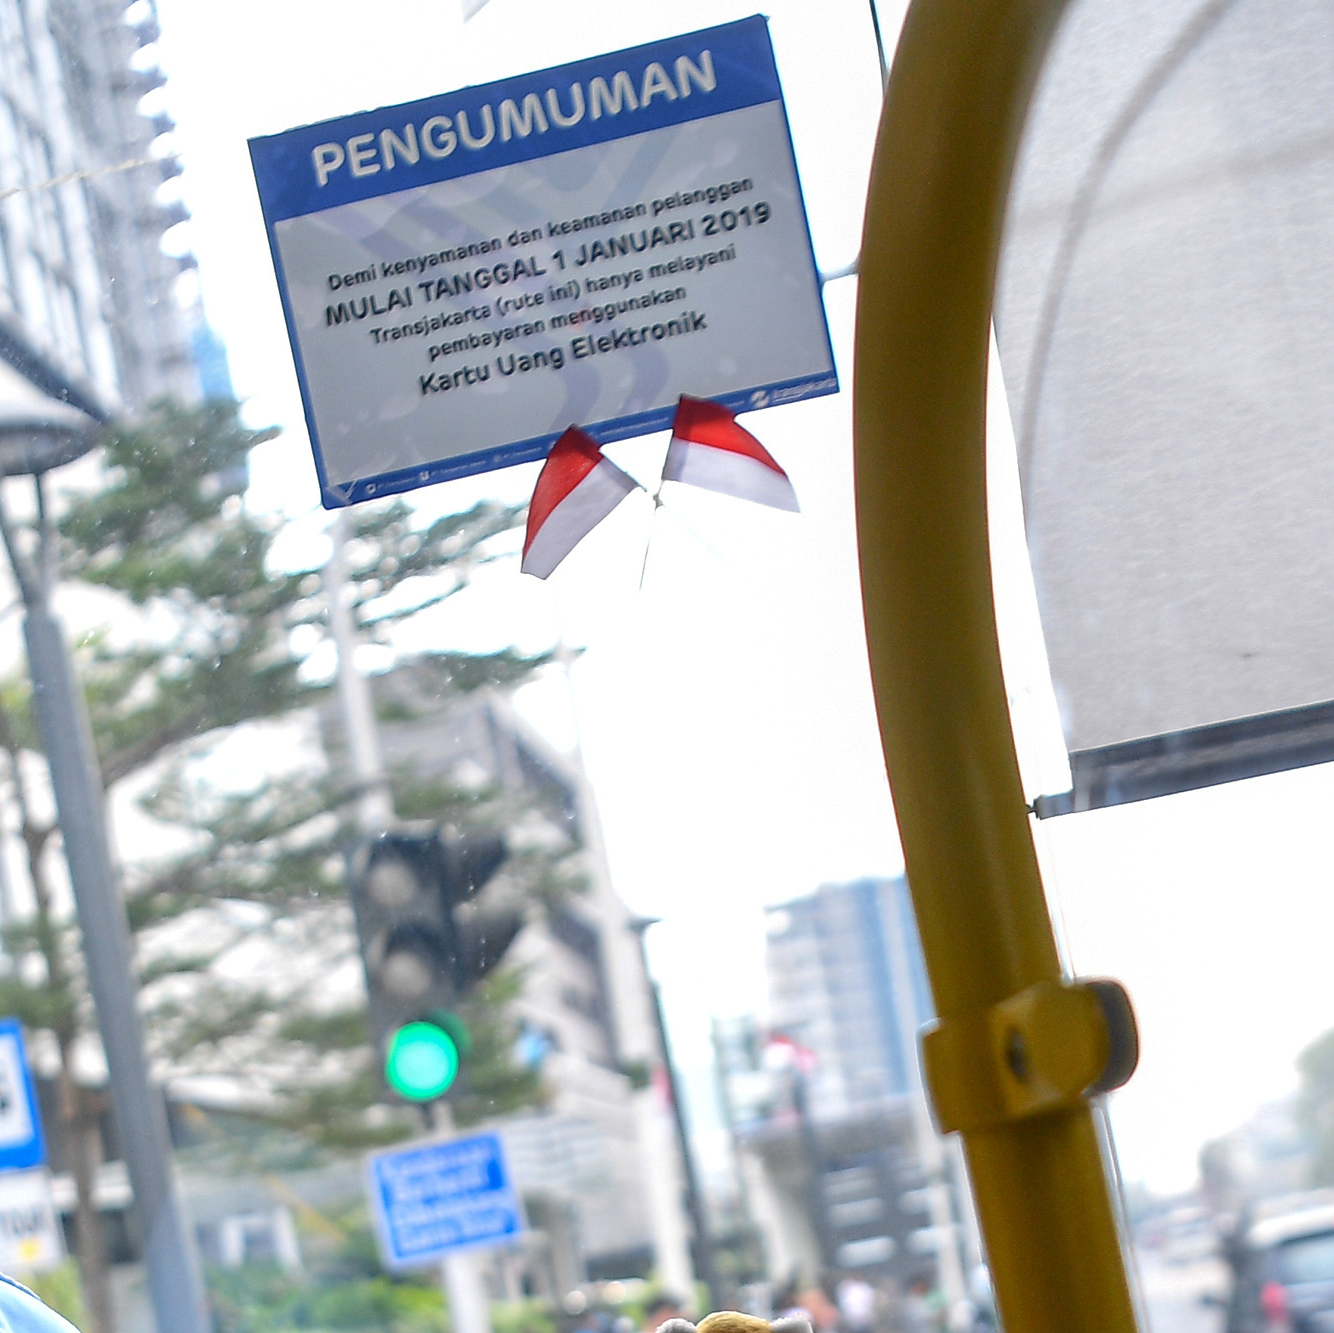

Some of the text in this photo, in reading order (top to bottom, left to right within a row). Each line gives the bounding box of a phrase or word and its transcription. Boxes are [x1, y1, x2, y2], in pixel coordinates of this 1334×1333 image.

[311, 50, 717, 187] PENGUMUMAN
[326, 201, 771, 327] MULAI TANGGAL 1 JANUARI 2019
[328, 177, 754, 290] Demi kenyamanan dan keamanan pelanggan
[370, 243, 736, 345] Transjakarta (rute ini) hanya melayani
[428, 286, 687, 362] pembayaran menggunakan
[419, 310, 708, 396] Kartu Uang Elektronik
